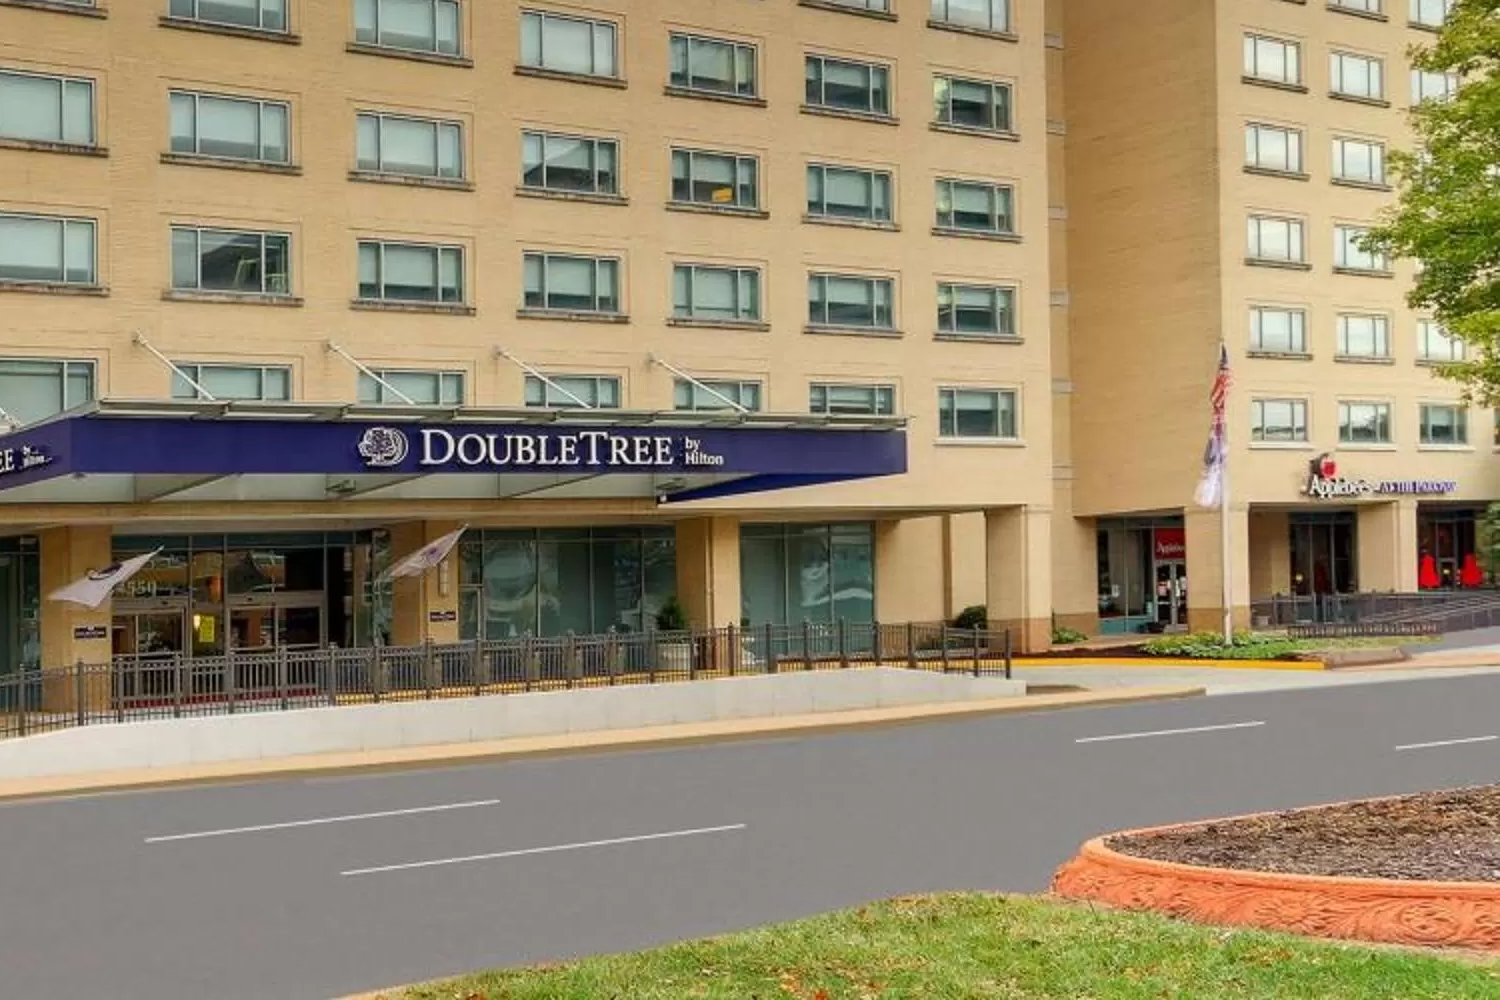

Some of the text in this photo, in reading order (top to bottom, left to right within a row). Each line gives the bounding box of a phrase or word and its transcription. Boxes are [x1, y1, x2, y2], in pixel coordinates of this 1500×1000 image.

[420, 429, 674, 465] DOUBLETREE
[685, 436, 700, 452] by
[685, 452, 724, 465] Hilton
